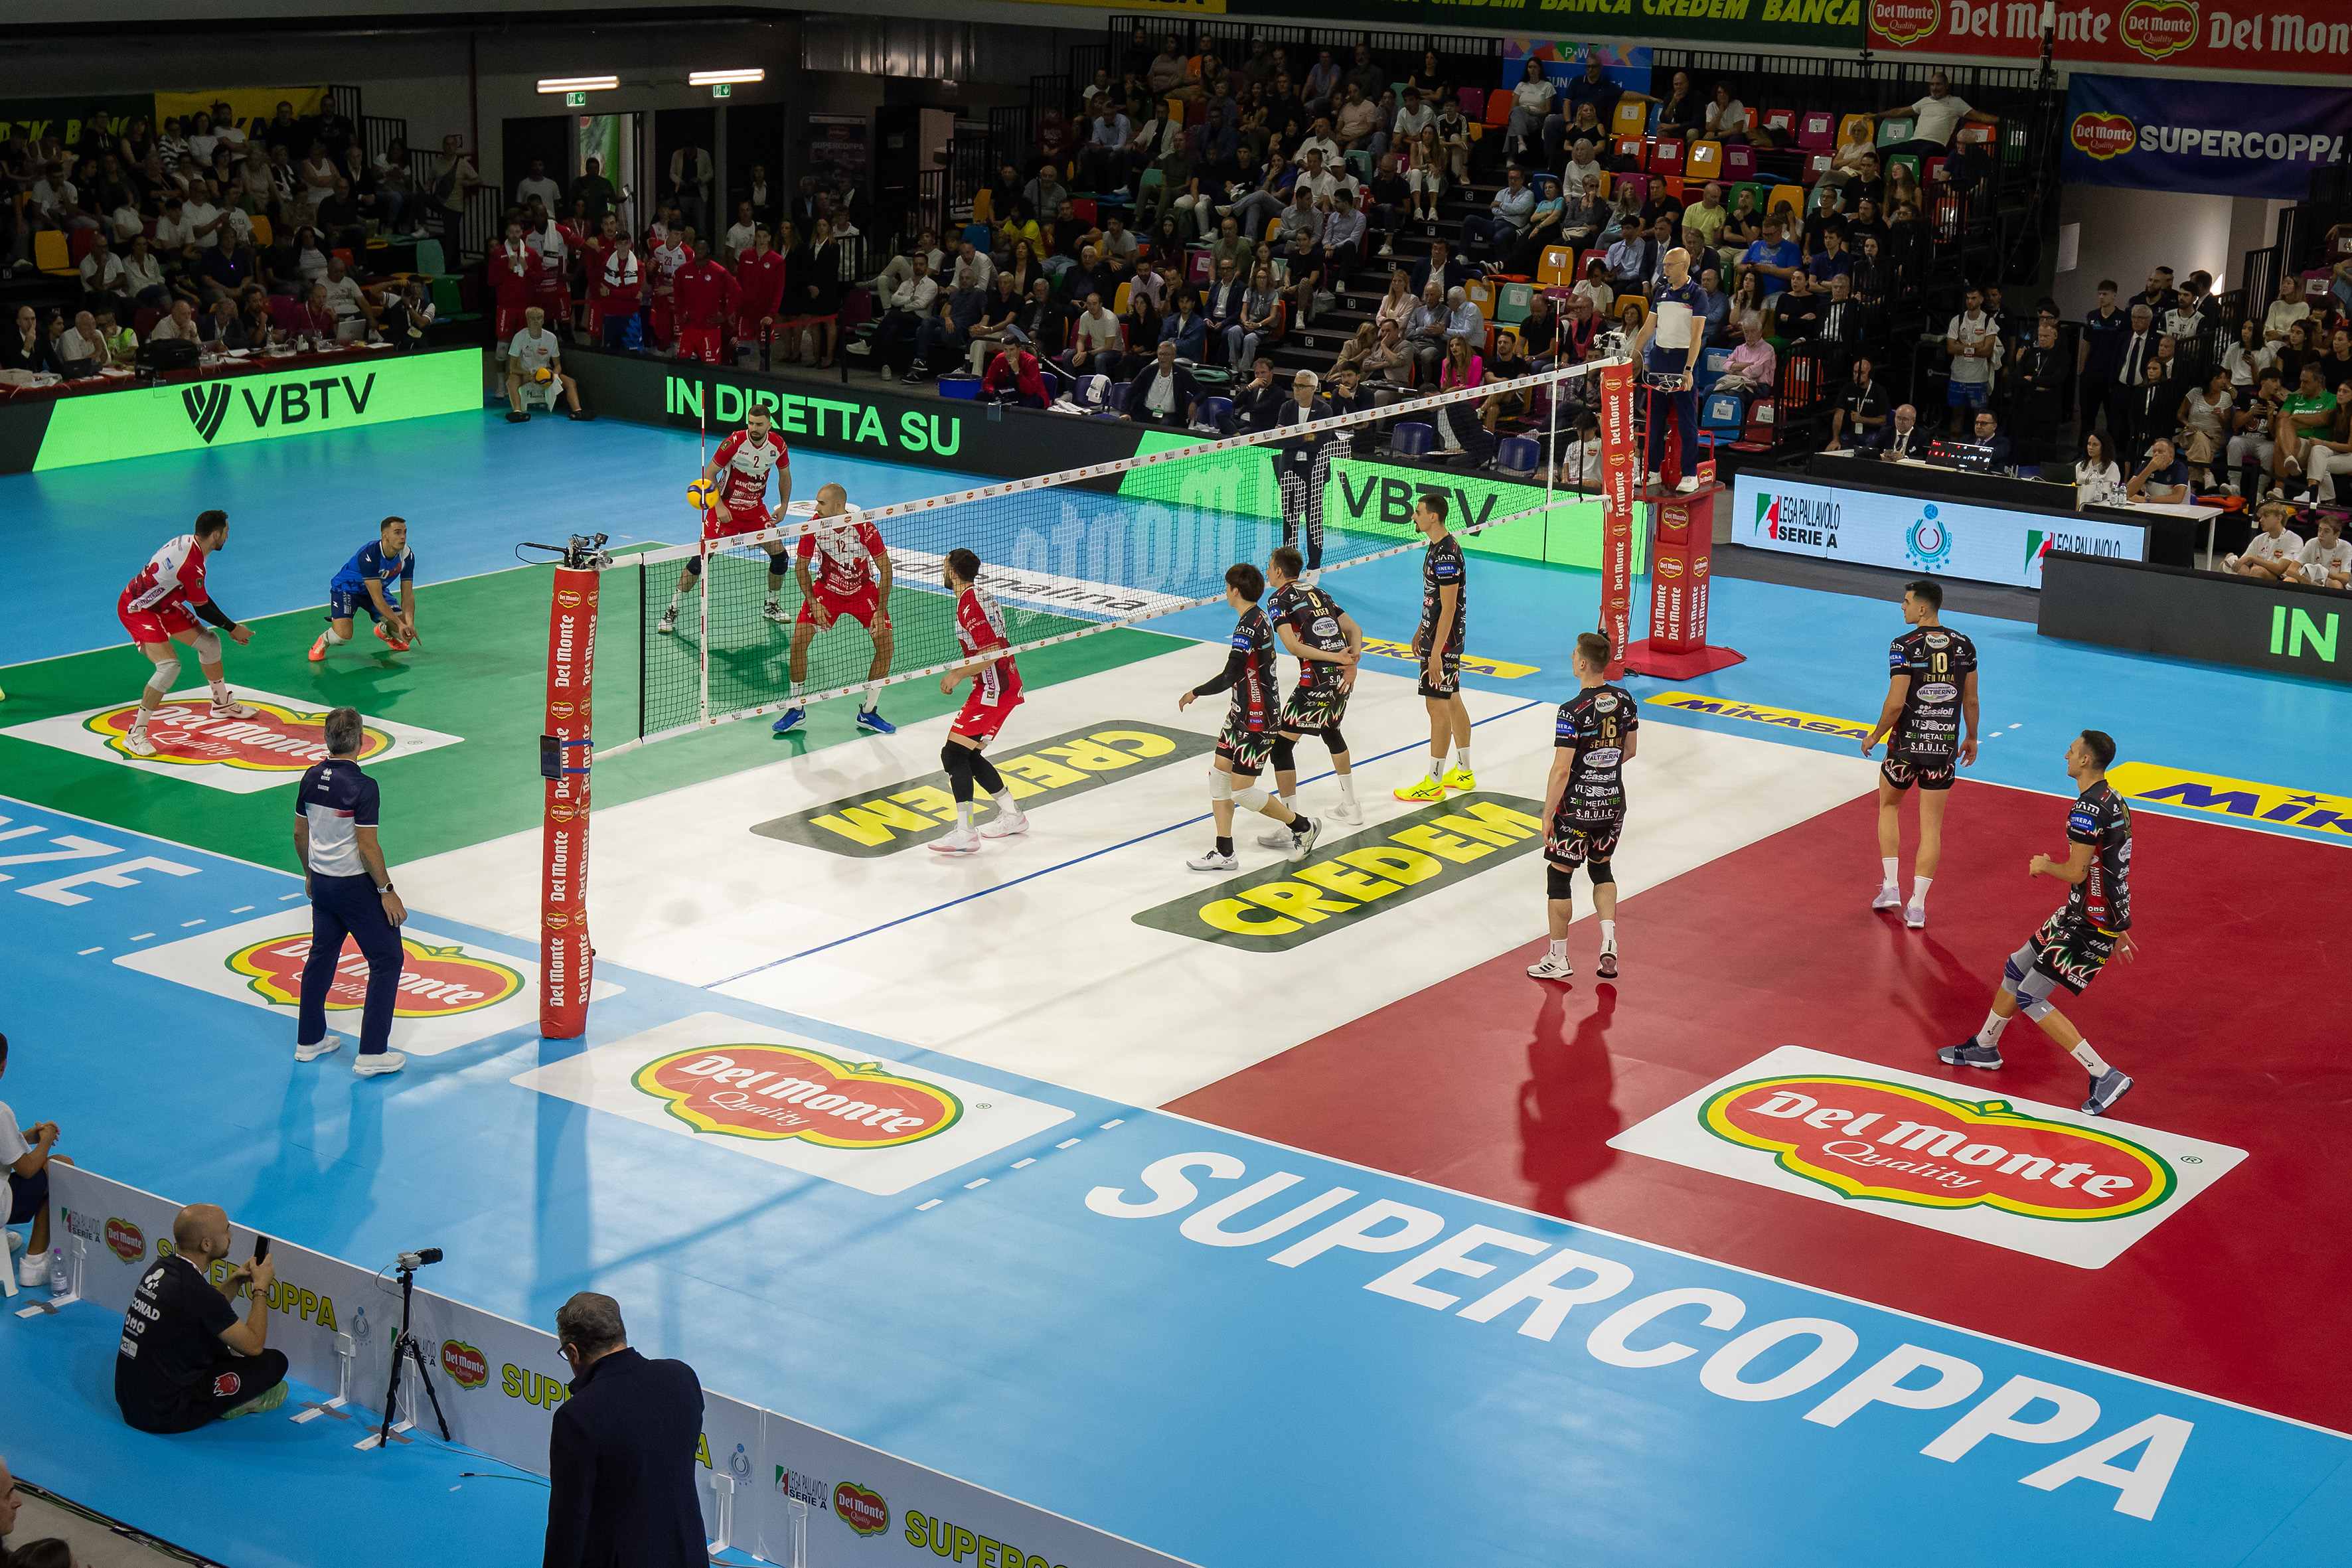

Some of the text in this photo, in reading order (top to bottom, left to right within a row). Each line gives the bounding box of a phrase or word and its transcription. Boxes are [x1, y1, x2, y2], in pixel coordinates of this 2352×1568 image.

[1642, 0, 1859, 26] CREDEM BANCA
[1876, 3, 1934, 21] Del Monte
[1948, 0, 2112, 43] Del Mnte
[2129, 15, 2192, 33] Del Monte
[2143, 32, 2173, 44] Quality
[2208, 11, 2352, 55] Del Mon
[2076, 124, 2132, 142] Del Monte
[241, 372, 376, 428] VBTV
[666, 376, 961, 456] IN DIRETTA SU
[1610, 395, 1621, 445] Del Monte
[753, 455, 759, 469] 2
[1615, 471, 1625, 500] Monte
[1779, 496, 1840, 530] LEGA PALLAVOLO
[836, 539, 848, 553] 12
[1778, 526, 1838, 548] SERIE A
[1614, 541, 1624, 591] Del Monte
[1308, 591, 1322, 608] 8
[1654, 584, 1667, 638] Del Monte
[1668, 587, 1682, 641] Del Monte
[583, 614, 597, 686] Del Monte
[2270, 605, 2339, 663] IN
[555, 614, 575, 688] Del Monte
[1932, 652, 1948, 674] 10
[1596, 699, 1617, 708] MONINI
[1667, 699, 1869, 740] MIKASA
[1922, 708, 1954, 716] cassioli
[148, 731, 241, 756] Quality
[1601, 716, 1617, 739] 16
[1585, 753, 1620, 762] VALTIBERIN
[808, 729, 1176, 847] CREEM
[550, 830, 569, 902] Del Monte
[578, 828, 589, 901] Del Monte
[1198, 800, 1545, 936] CREDEM
[549, 937, 565, 1007] Del Monte
[578, 933, 588, 1005] Del Monte
[675, 1054, 925, 1133] Del Monte
[708, 1091, 811, 1128] Quality
[1747, 1089, 2134, 1198] Del Monte
[1821, 1140, 1983, 1189] Quality
[72, 1227, 101, 1243] SERIE A
[108, 1227, 142, 1249] Del Monte
[1083, 1150, 2195, 1521] SUPERCOPPA
[403, 1349, 436, 1368] SEE A
[445, 1350, 485, 1374] Del Monte
[789, 1470, 828, 1502] LEGA PALLAVOLO
[789, 1489, 828, 1510] SERIE A
[838, 1492, 884, 1520] Del Monte
[850, 1510, 870, 1526] Quality
